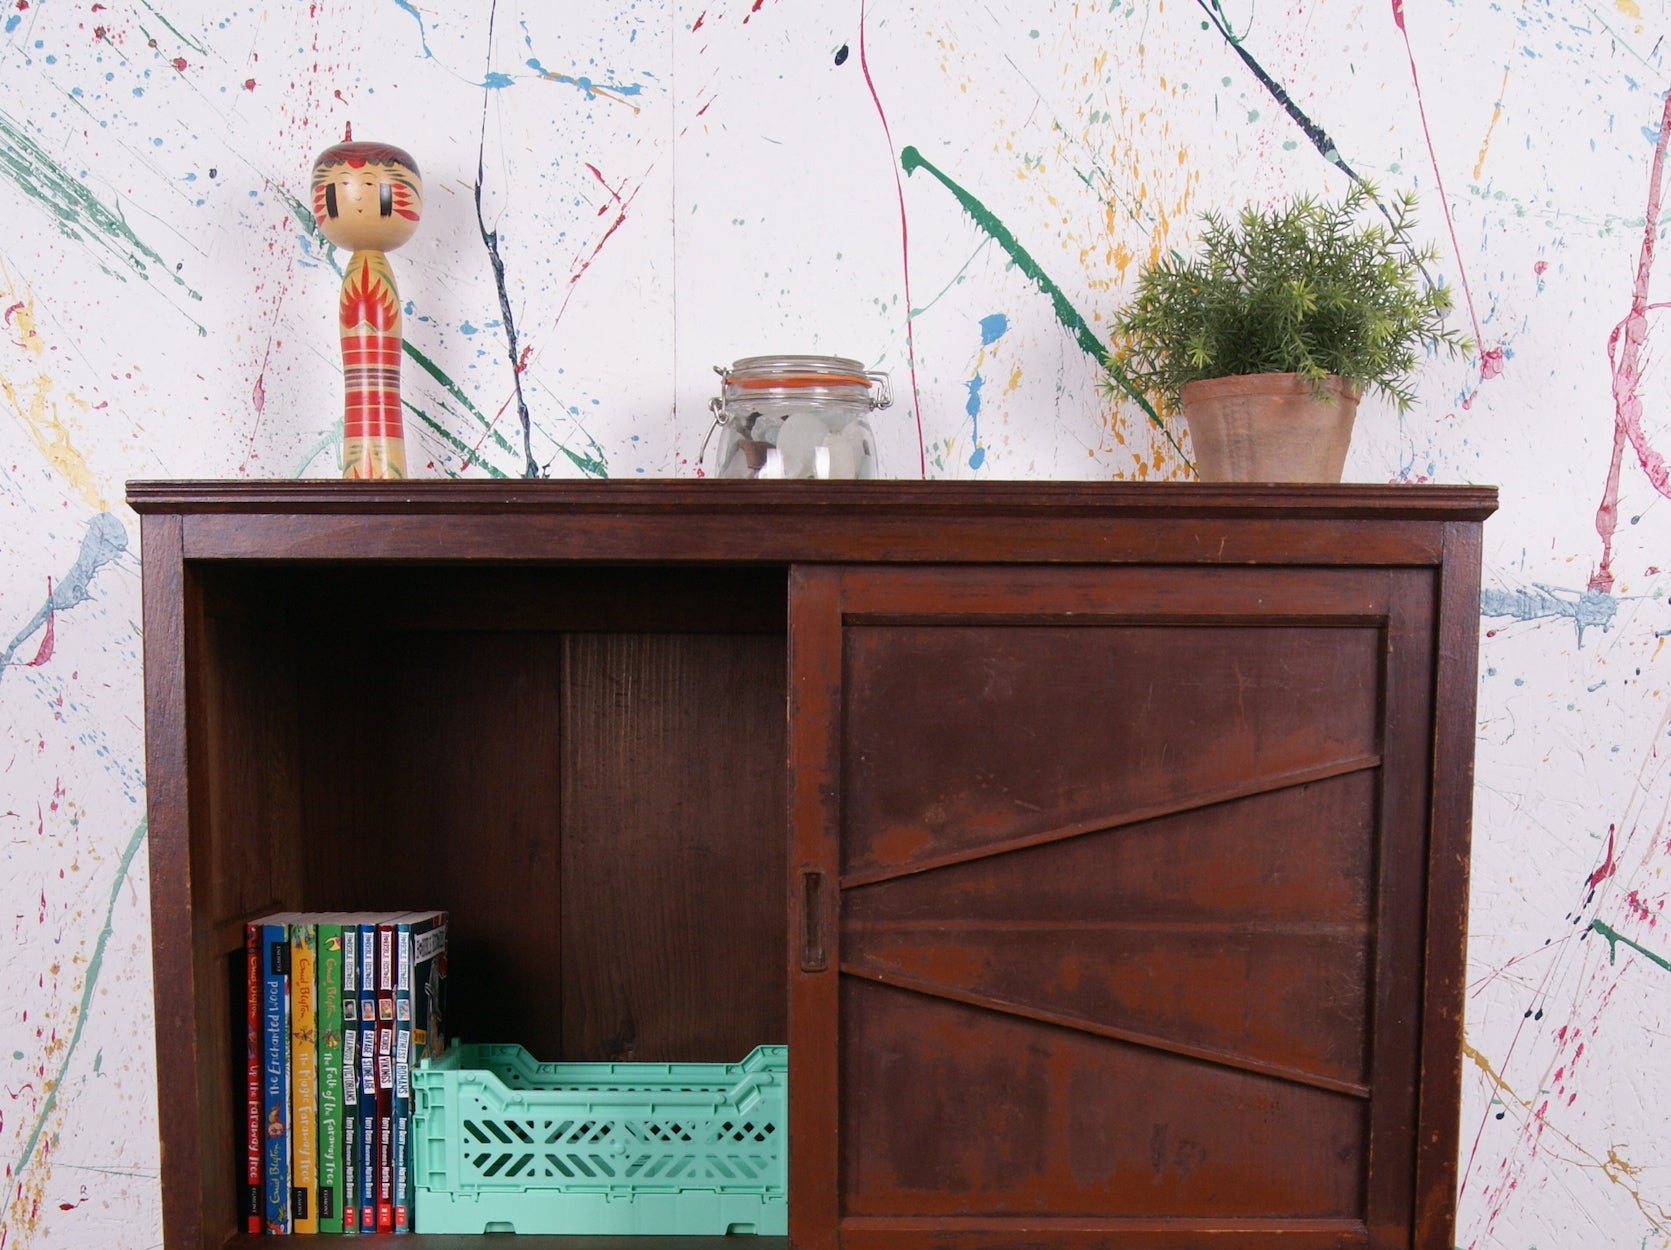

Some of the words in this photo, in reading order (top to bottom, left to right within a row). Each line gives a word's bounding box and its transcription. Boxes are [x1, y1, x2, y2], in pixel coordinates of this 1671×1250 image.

[299, 958, 310, 983] Enid
[267, 981, 279, 1011] Wood
[299, 987, 311, 1018] Blyton
[324, 987, 337, 1018] Blyton
[267, 1015, 281, 1075] Enchanted
[364, 1032, 373, 1053] SAVAGE
[398, 1031, 408, 1059] RUTHLESS
[323, 1053, 332, 1065] The
[363, 1060, 373, 1077] STONE
[380, 1057, 391, 1084] VIKINGS
[269, 1077, 280, 1095] The
[299, 1069, 311, 1101] Magic
[326, 1067, 338, 1088] Folk
[345, 1066, 355, 1102] VICTORIANS
[365, 1079, 374, 1090] AGE
[398, 1066, 407, 1094] ROMANS
[322, 1091, 336, 1102] of
[248, 1101, 260, 1151] Faraway
[298, 1106, 312, 1155] Faraway
[322, 1119, 336, 1159] Faraway
[269, 1143, 282, 1175] Blyton
[299, 1158, 312, 1183] Tree
[325, 1161, 337, 1185] Tree
[269, 1178, 280, 1204] Enid
